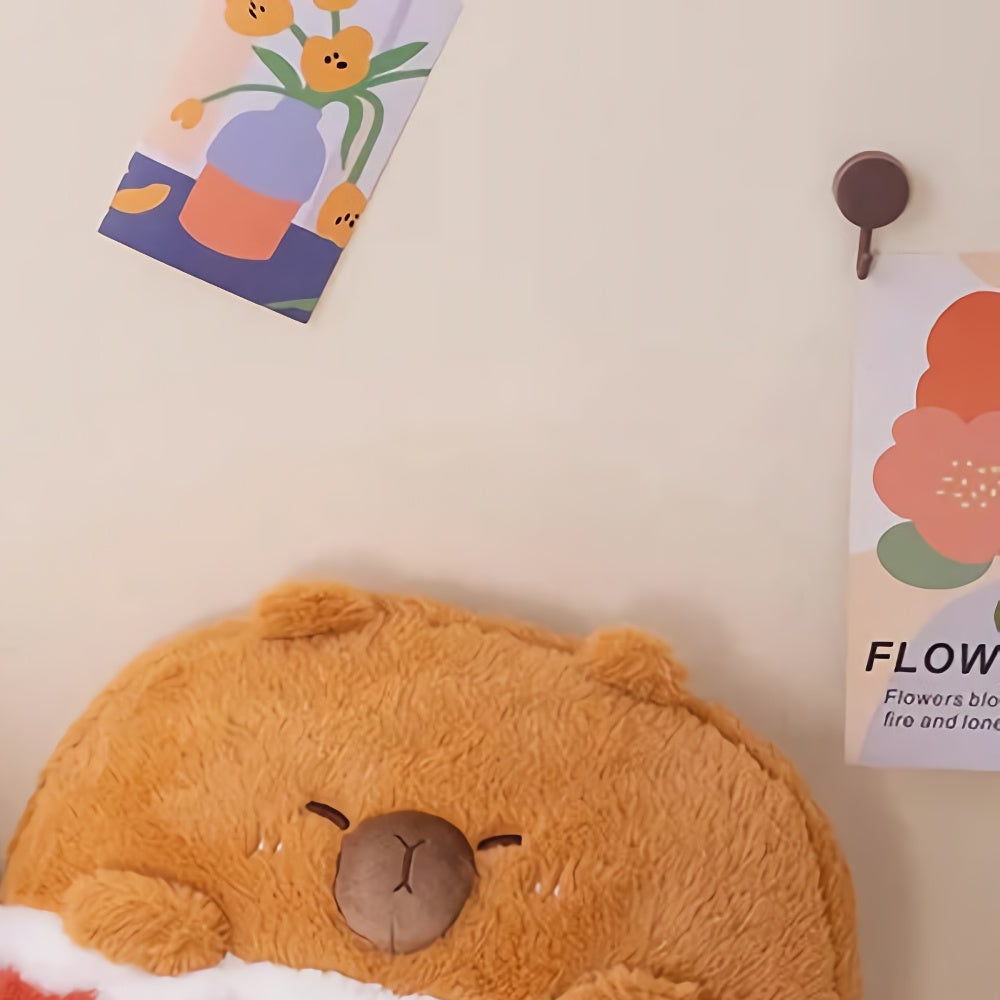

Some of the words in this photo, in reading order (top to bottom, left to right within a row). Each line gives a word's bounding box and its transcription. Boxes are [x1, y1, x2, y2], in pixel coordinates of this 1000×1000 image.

[884, 689, 963, 707] Flowers
[884, 711, 914, 728] fire
[920, 714, 958, 730] and
